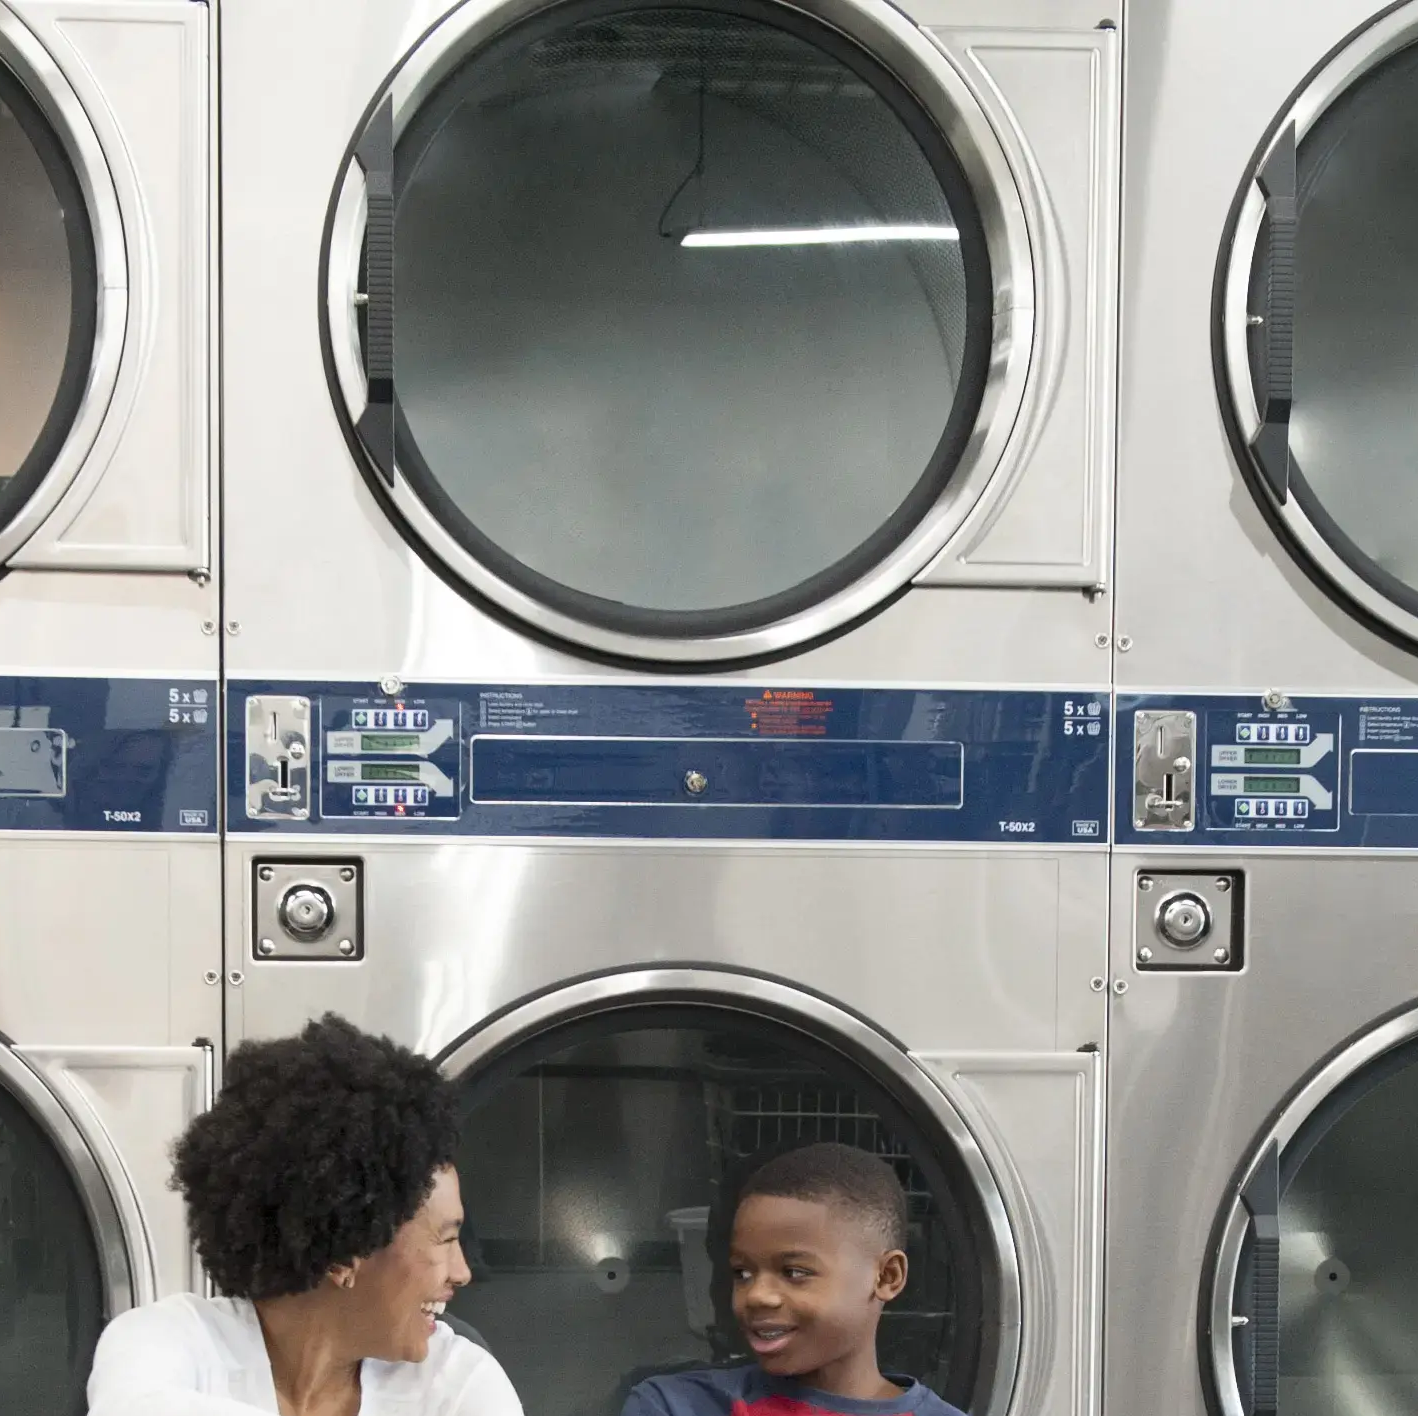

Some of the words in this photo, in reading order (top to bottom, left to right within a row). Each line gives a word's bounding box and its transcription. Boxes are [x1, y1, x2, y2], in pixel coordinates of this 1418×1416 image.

[169, 688, 179, 703] 5
[182, 692, 190, 703] x
[169, 708, 179, 723] 5
[182, 713, 190, 723] x
[1064, 701, 1074, 716] 5
[1077, 706, 1084, 716] x
[1064, 721, 1074, 735] 5
[1076, 726, 1084, 735] x
[999, 821, 1036, 833] T-50X2
